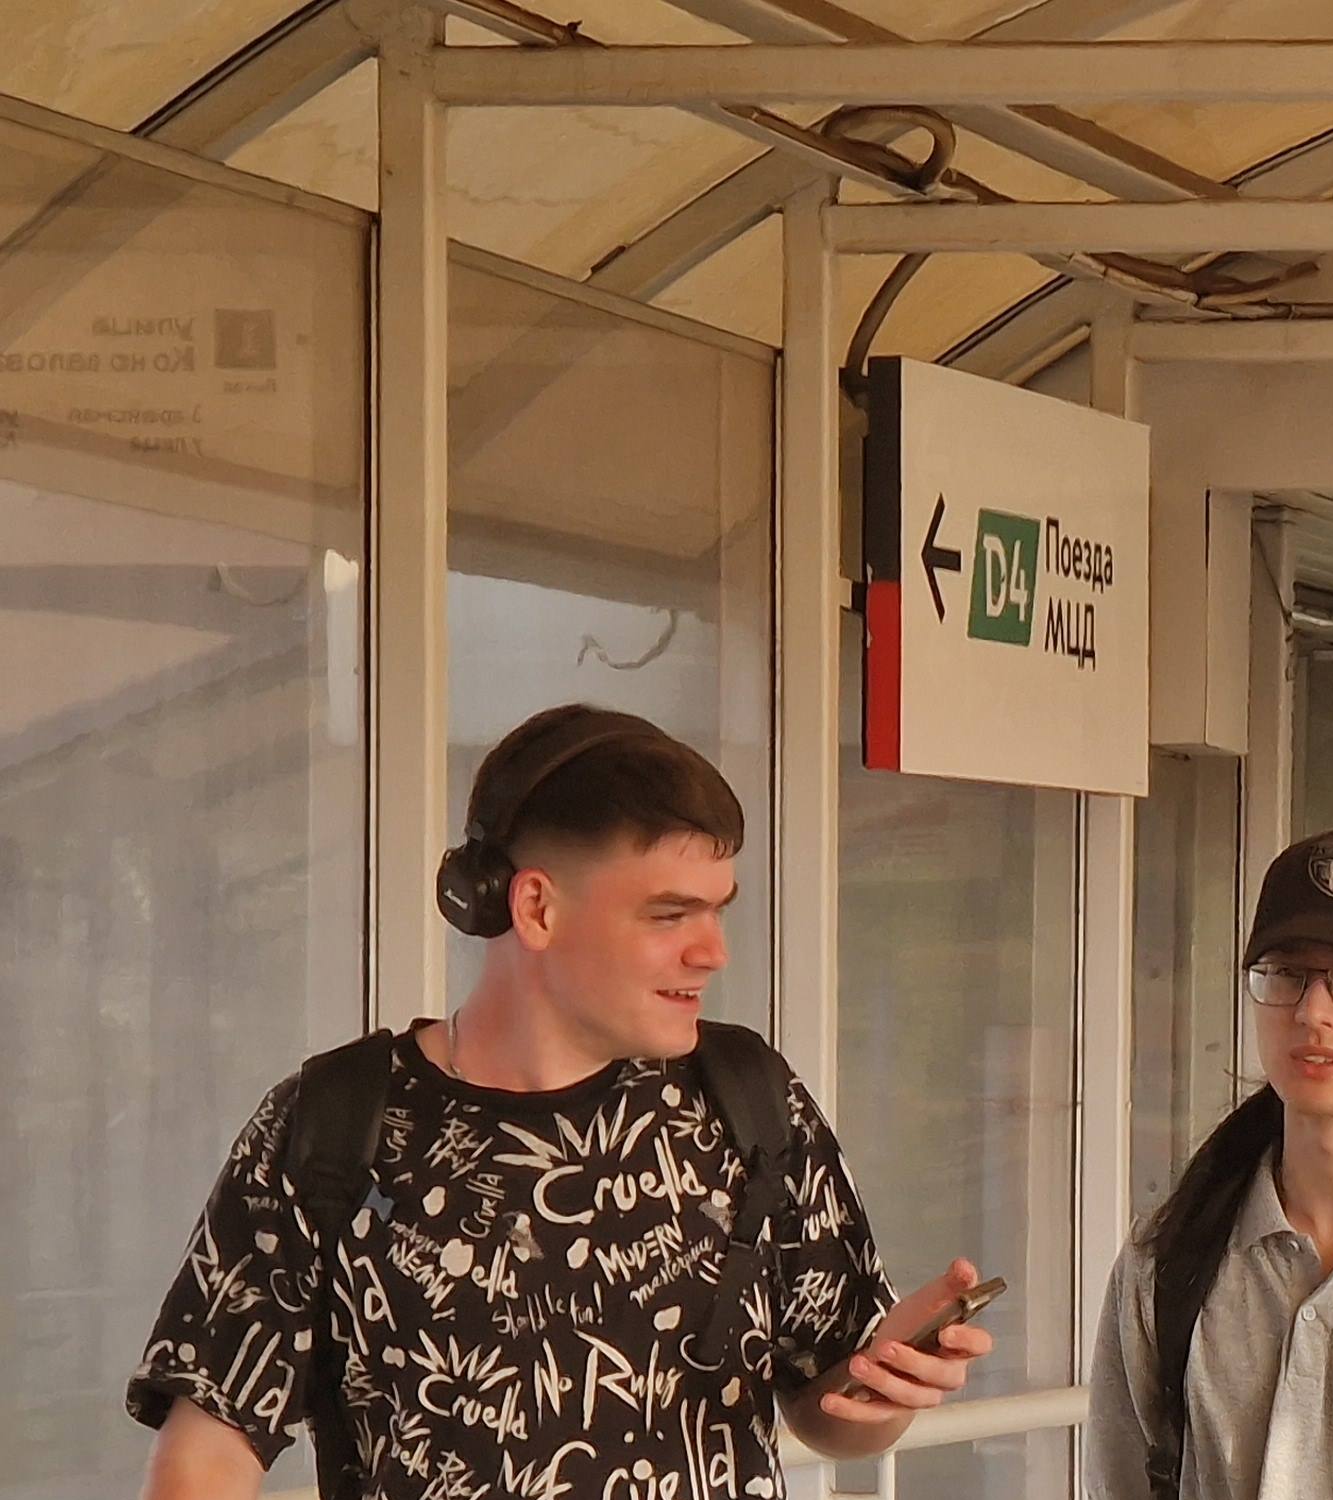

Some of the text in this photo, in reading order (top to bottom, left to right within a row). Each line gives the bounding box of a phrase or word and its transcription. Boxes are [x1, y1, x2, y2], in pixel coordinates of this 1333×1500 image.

[982, 534, 1029, 623] D4
[1045, 517, 1114, 594] Поезда
[1044, 597, 1097, 673] МЦД
[533, 1126, 708, 1225] Cruella
[417, 1372, 529, 1445] Cruella
[573, 1328, 685, 1436] Rules
